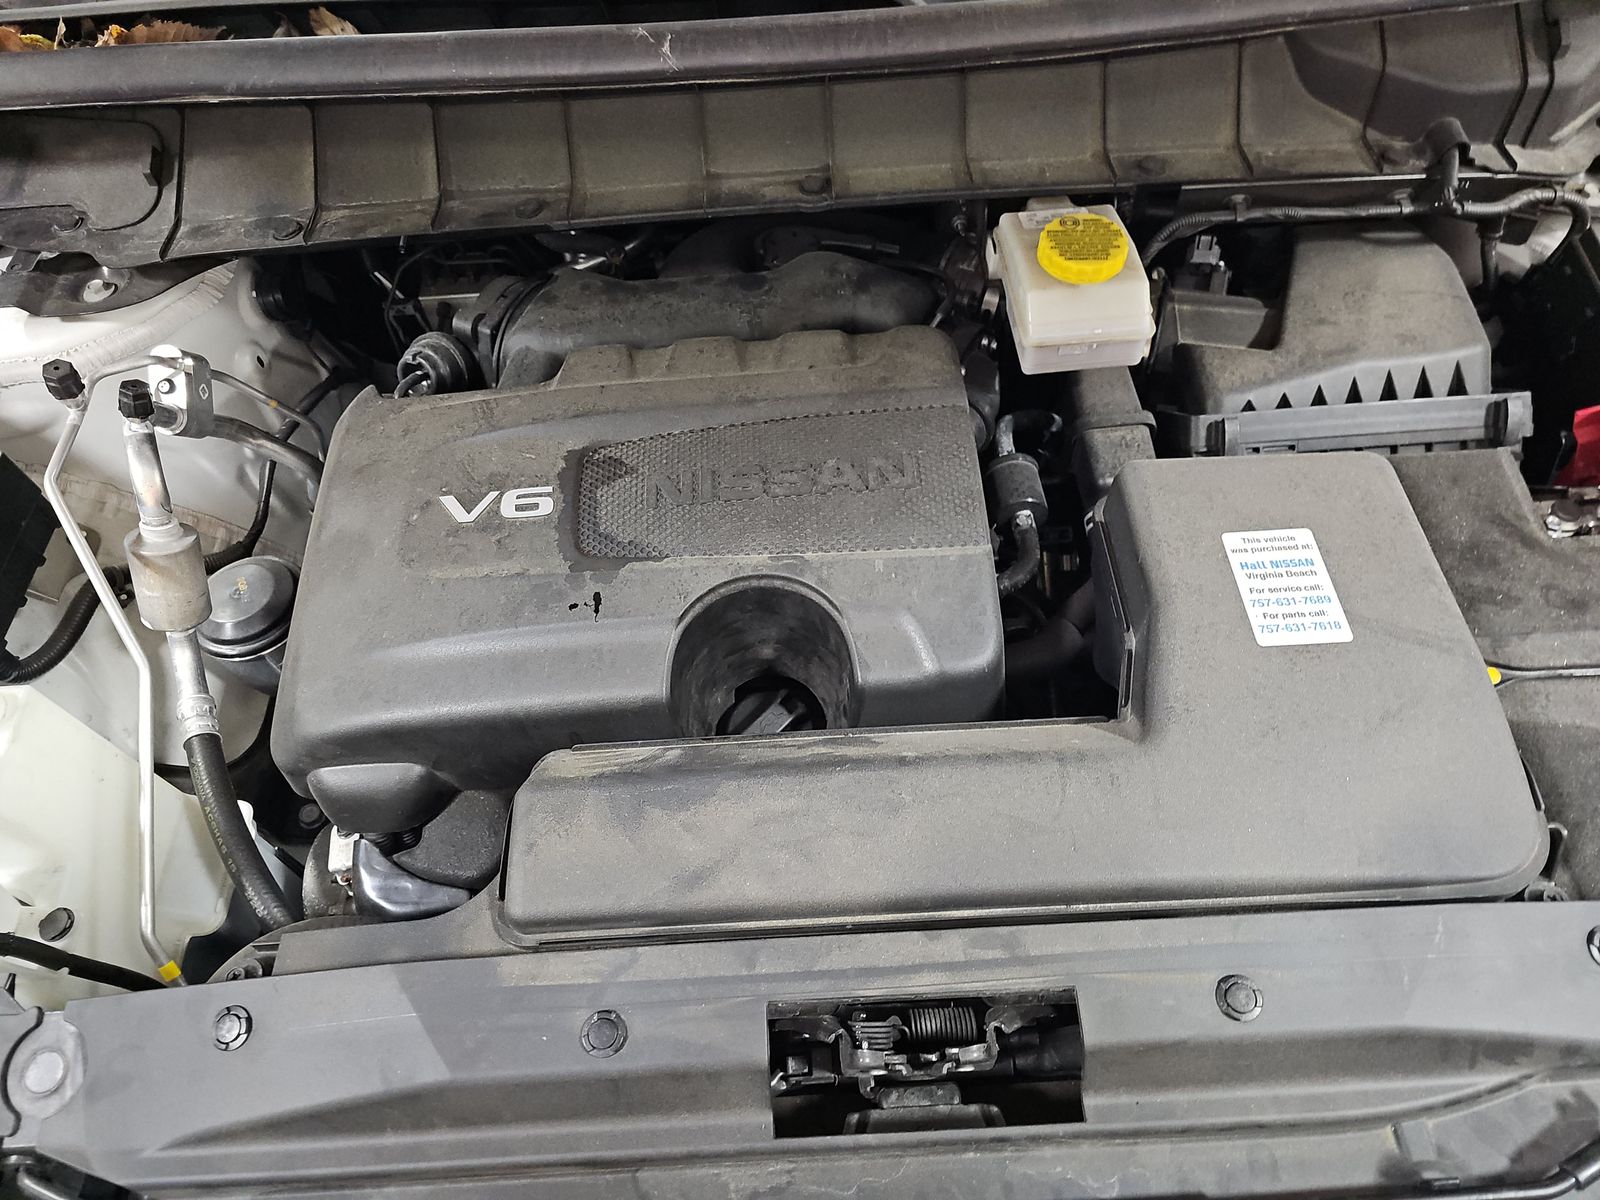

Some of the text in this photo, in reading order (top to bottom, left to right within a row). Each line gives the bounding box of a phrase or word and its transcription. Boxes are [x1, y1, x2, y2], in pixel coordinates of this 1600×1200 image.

[439, 487, 554, 524] V6
[1263, 535, 1296, 543] vehicle
[1230, 546, 1249, 554] was
[1251, 543, 1299, 554] purchased
[1239, 558, 1315, 571] Hall NISSAN
[1244, 569, 1317, 581] Virginia Beach
[1249, 584, 1324, 595] For service call:
[1249, 595, 1332, 608] 757-631-7689
[1262, 609, 1329, 621] For parts call:
[1258, 621, 1342, 634] 757-631-7618
